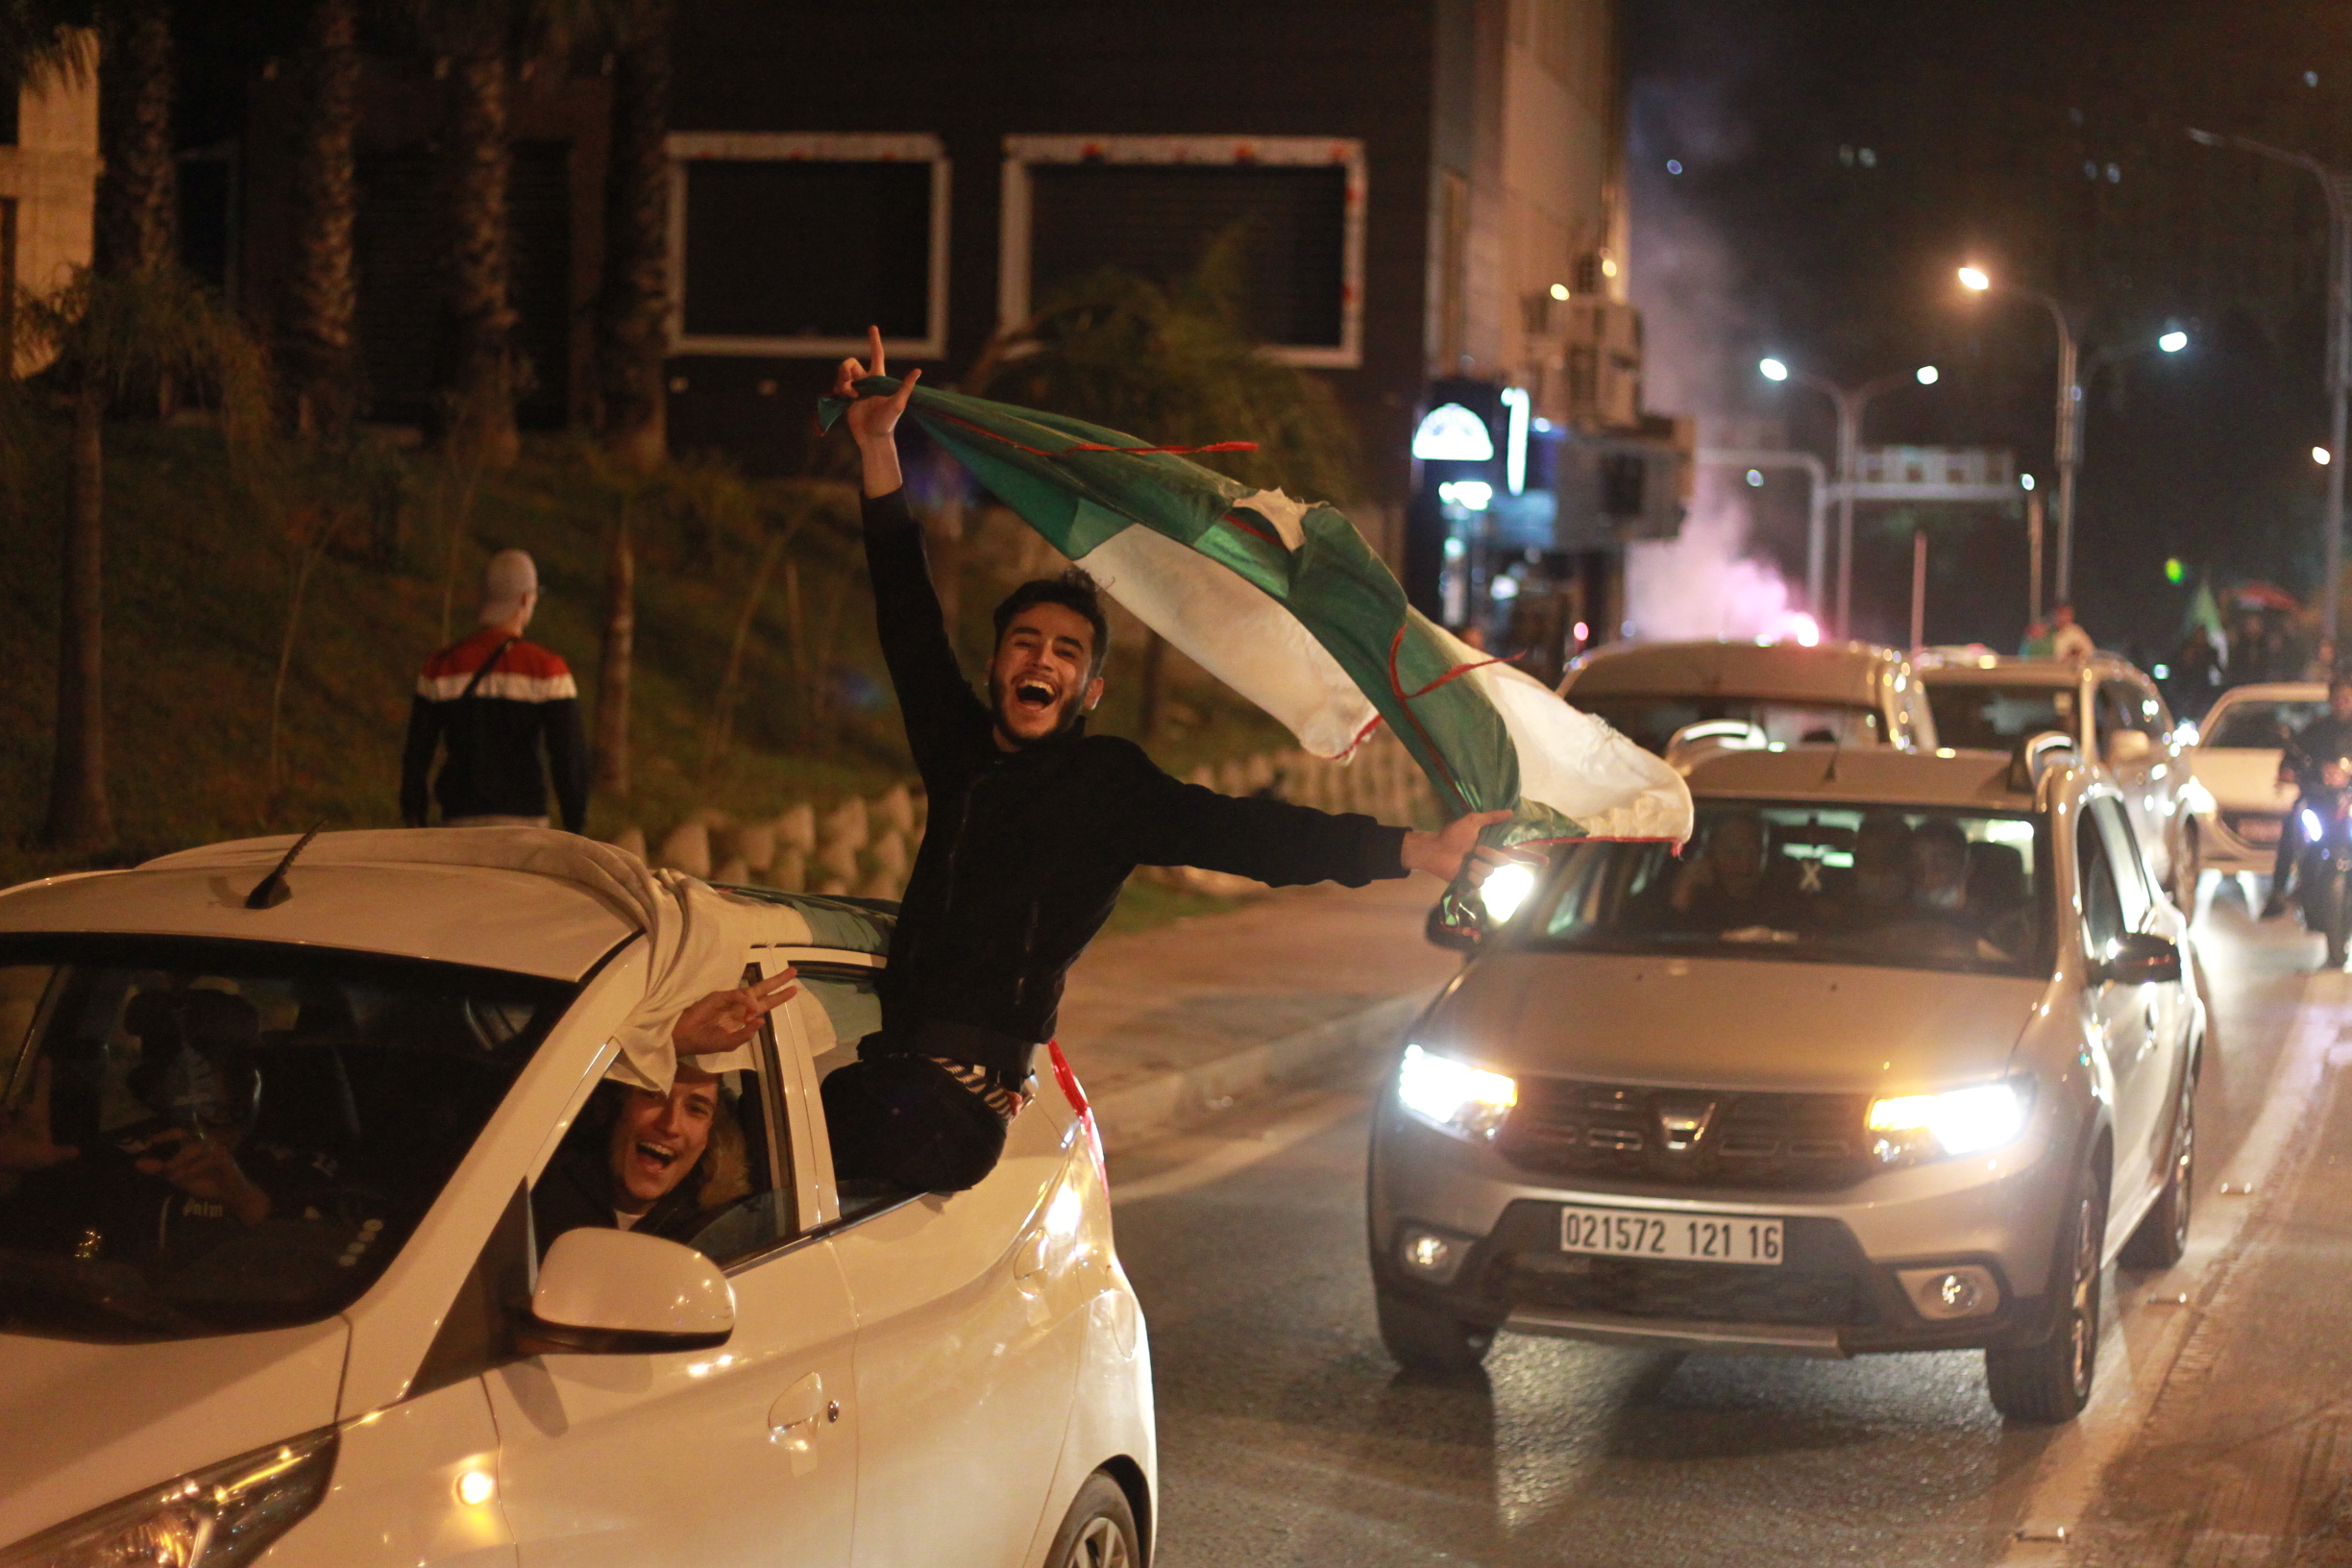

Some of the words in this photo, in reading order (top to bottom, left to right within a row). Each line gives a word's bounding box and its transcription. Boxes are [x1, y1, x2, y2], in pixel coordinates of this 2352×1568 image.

[1565, 1213, 1666, 1254] 021572
[1687, 1220, 1731, 1257] 121
[1749, 1224, 1779, 1260] 16
